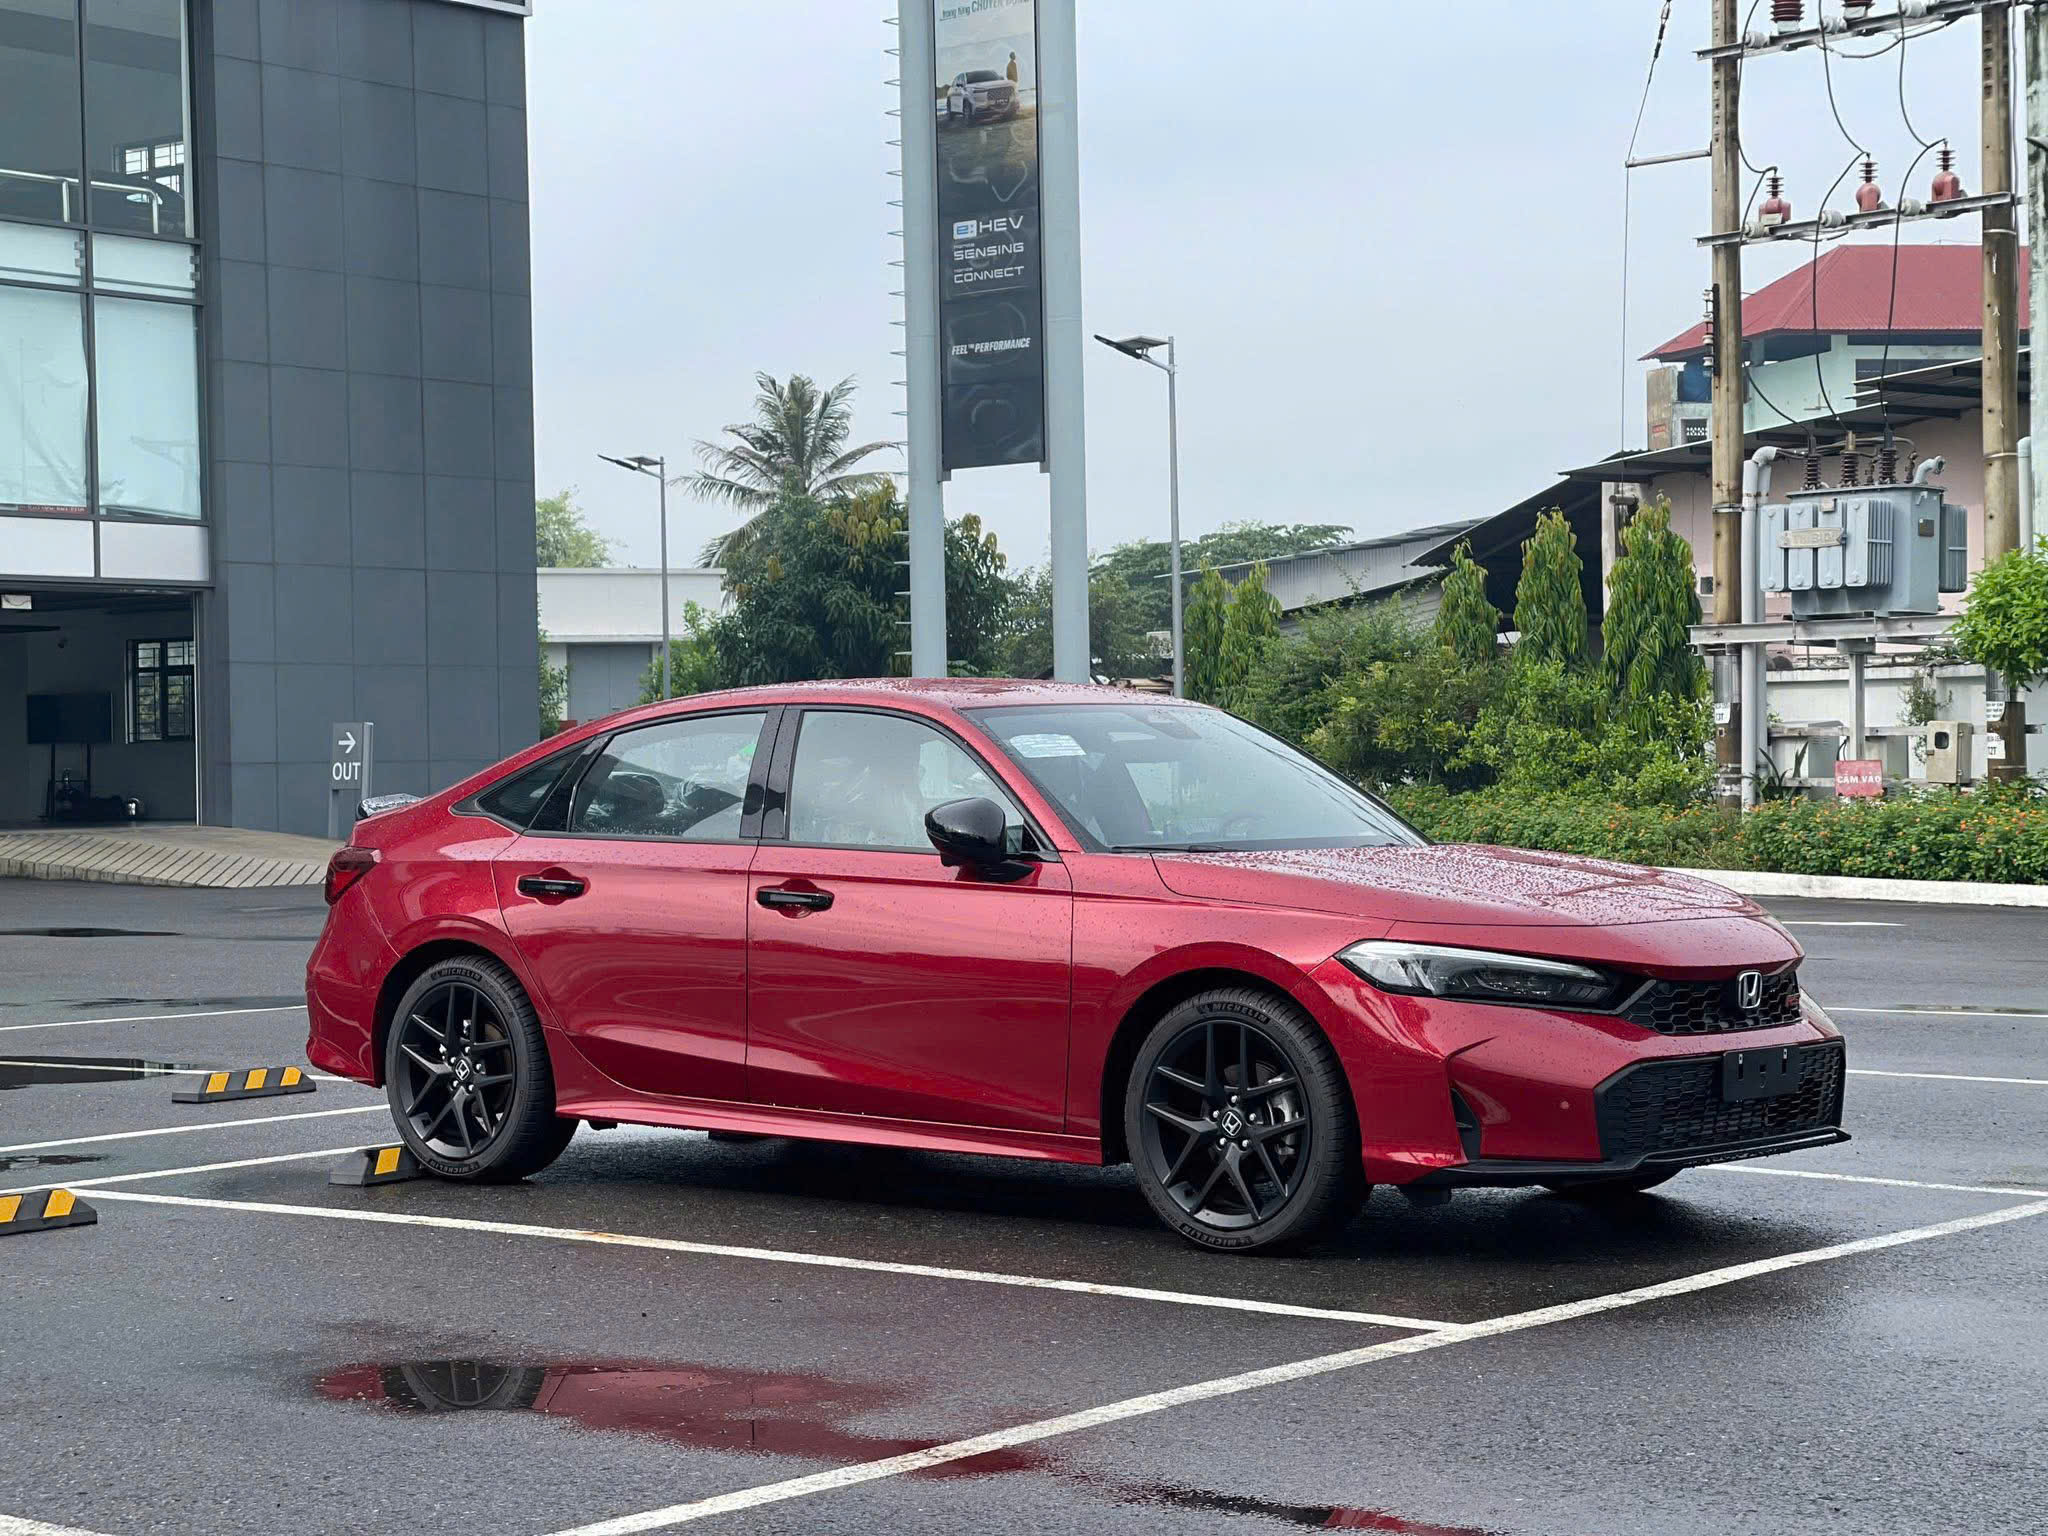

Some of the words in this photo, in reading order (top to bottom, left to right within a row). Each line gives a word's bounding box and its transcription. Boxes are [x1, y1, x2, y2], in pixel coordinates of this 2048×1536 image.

[954, 242, 1024, 260] SENSING
[954, 265, 1025, 283] CONNECT
[951, 344, 968, 355] FEEL
[974, 337, 1031, 353] PERFORMANCE
[332, 761, 361, 780] OUT
[442, 967, 481, 979] MICHELIN
[1213, 1003, 1268, 1023] MICHELIN
[1182, 1226, 1237, 1247] MICHELIN
